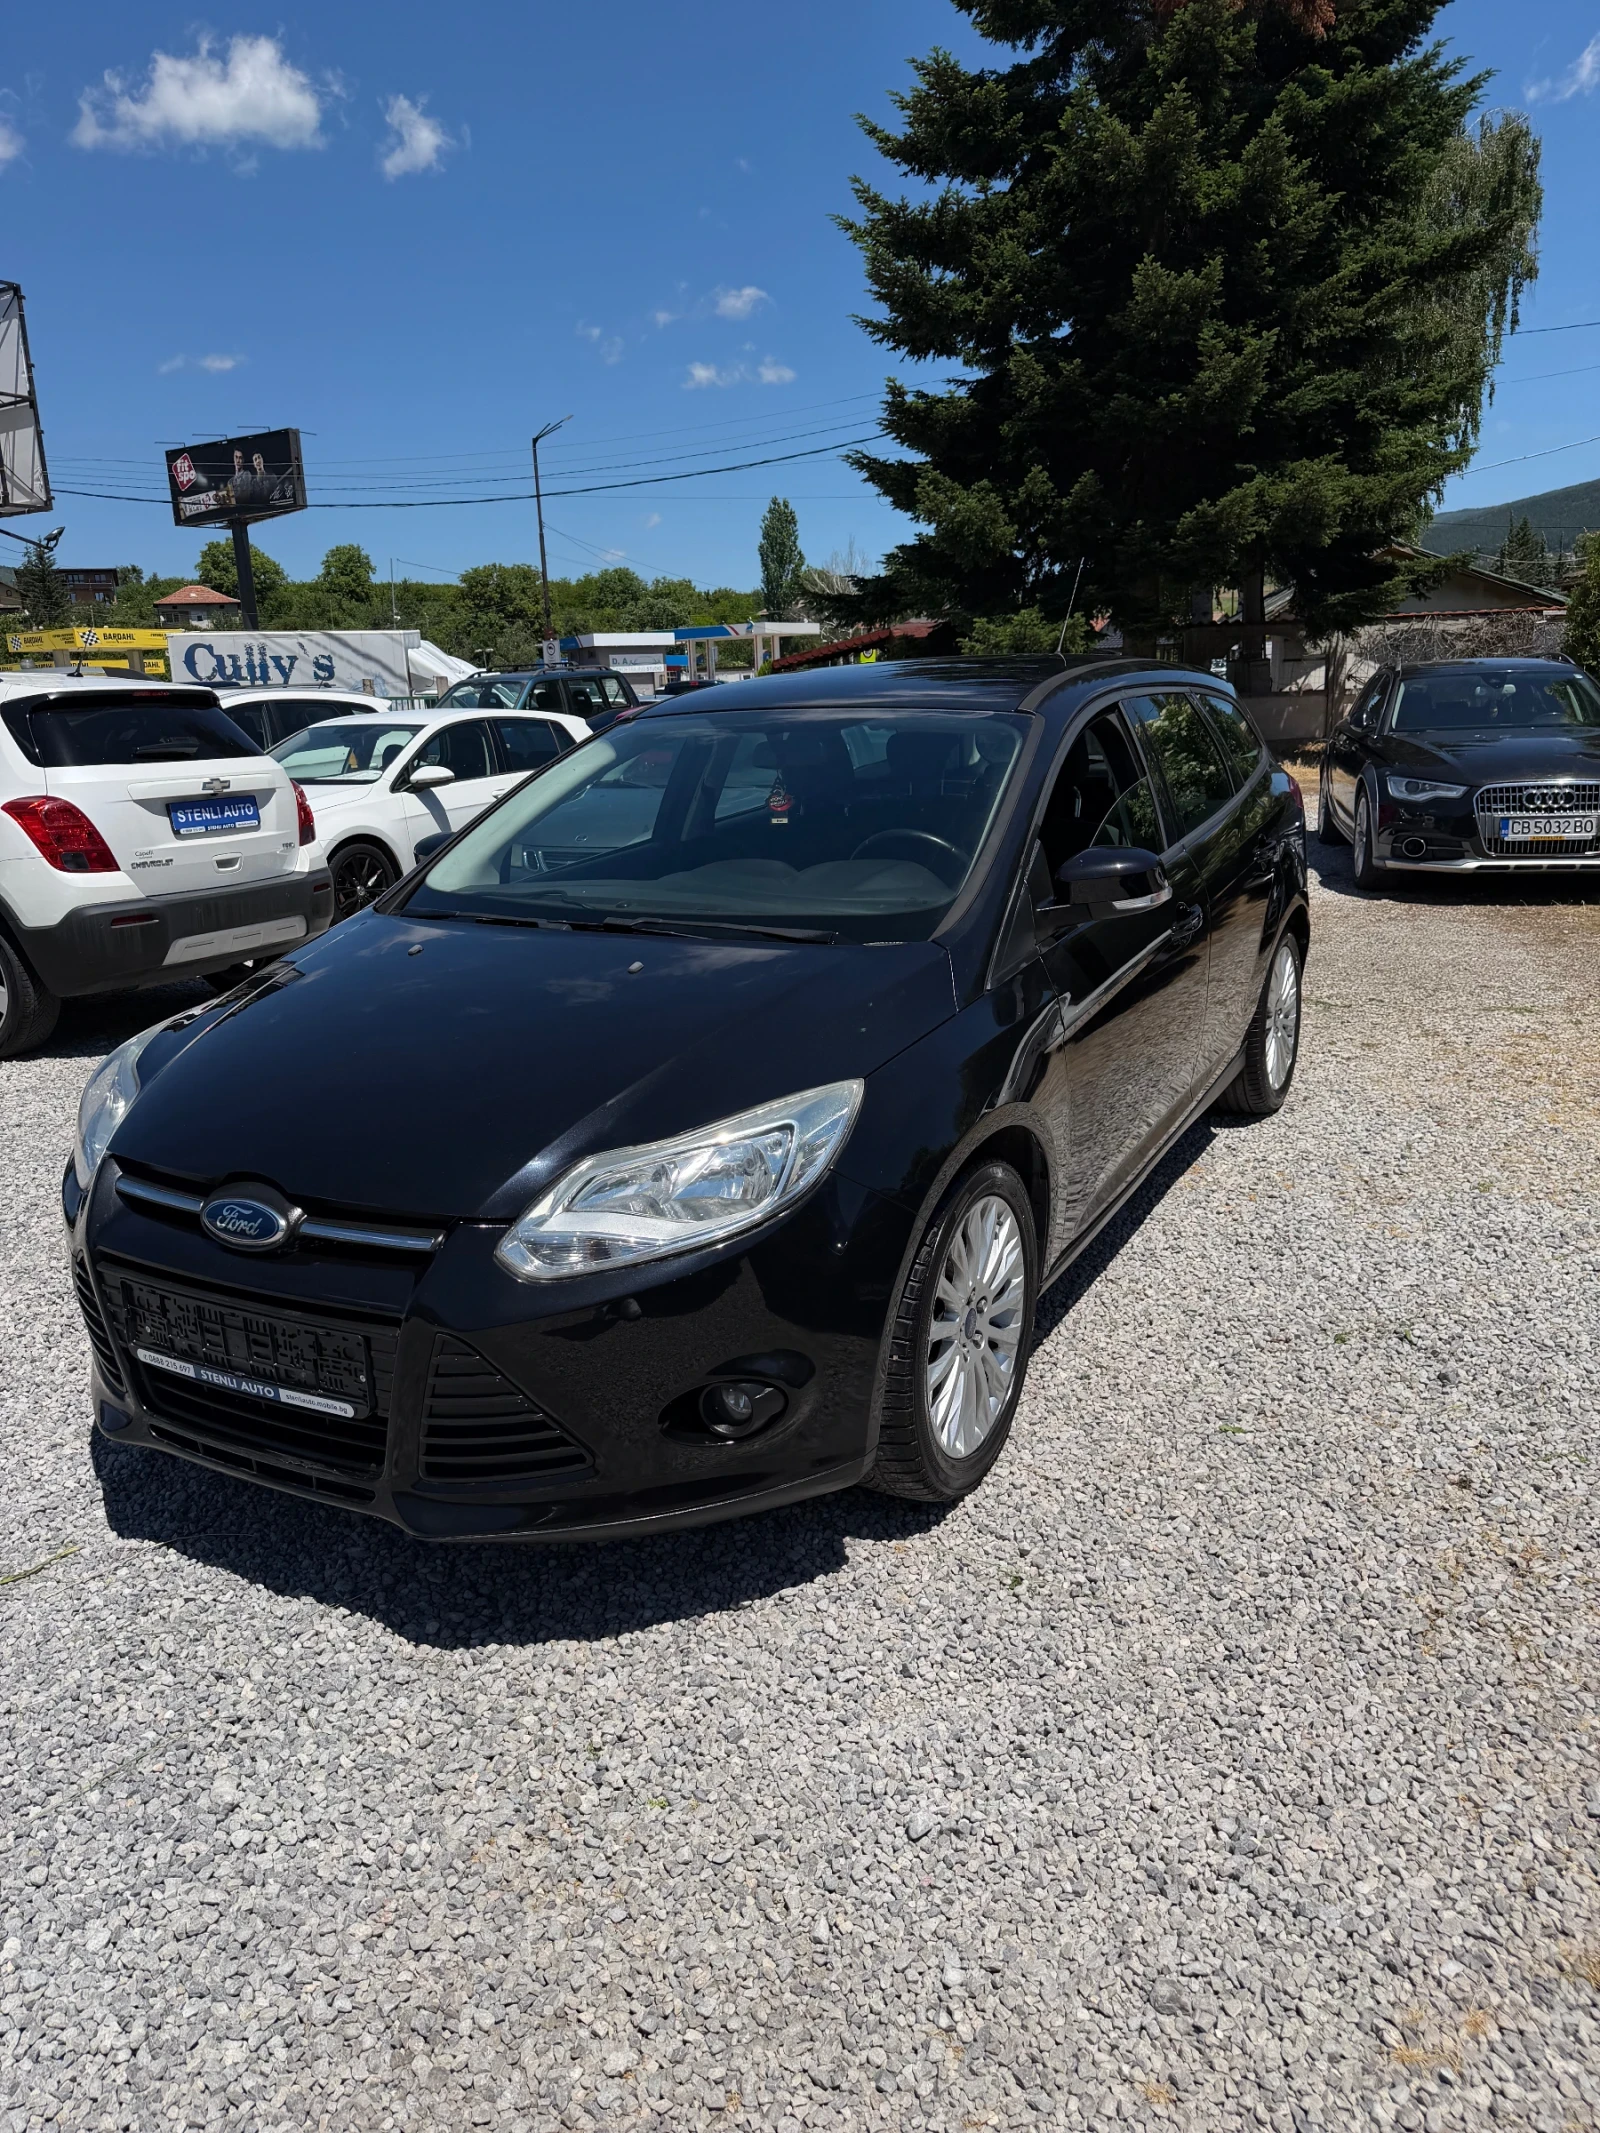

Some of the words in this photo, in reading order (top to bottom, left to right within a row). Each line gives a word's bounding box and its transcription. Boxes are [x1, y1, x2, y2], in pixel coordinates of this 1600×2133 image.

[178, 471, 196, 484] spo
[103, 633, 136, 643] BARDAHL
[177, 807, 221, 822] STENLI
[224, 803, 254, 818] AUTO
[1512, 820, 1531, 835] CB
[1533, 820, 1571, 834] 5032
[1574, 819, 1594, 833] BO
[131, 858, 173, 869] CHEVROLET
[216, 1204, 263, 1236] Ford
[165, 1360, 178, 1370] 215
[200, 1369, 237, 1388] STENLI
[241, 1381, 274, 1397] AUTO
